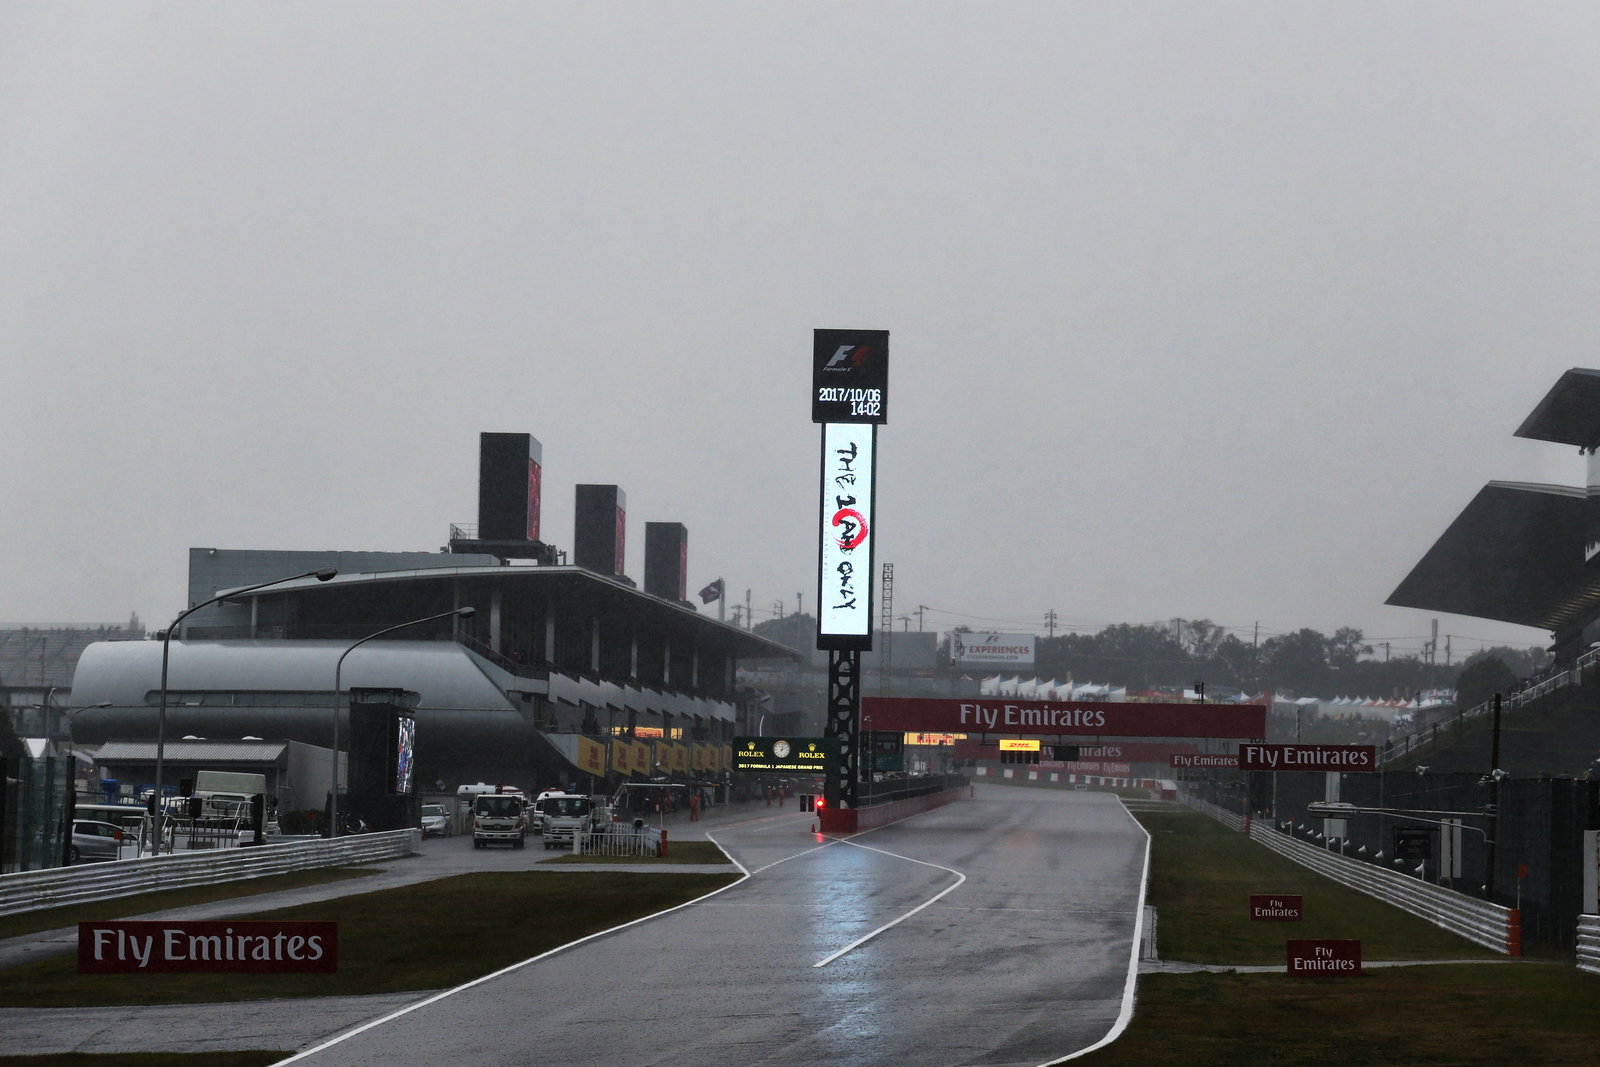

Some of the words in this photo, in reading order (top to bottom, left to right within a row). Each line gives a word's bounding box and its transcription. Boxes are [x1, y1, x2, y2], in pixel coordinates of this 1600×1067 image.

[819, 387, 881, 402] 2017/10/06
[850, 401, 881, 416] 14:02
[835, 442, 858, 490] THE
[832, 560, 857, 610] ONLY
[969, 645, 1029, 655] EXPERIENCES
[960, 703, 998, 729] Fly
[1004, 704, 1106, 727] Emirates
[738, 750, 765, 758] ROLEX
[798, 751, 825, 759] ROLEX
[1174, 756, 1192, 767] Fly
[1193, 756, 1239, 767] Emirates
[1247, 747, 1279, 767] Fly
[1284, 747, 1369, 765] Emirates
[1255, 907, 1298, 917] Emirates
[93, 929, 154, 968] Fly
[163, 927, 324, 961] Emirates
[1315, 947, 1333, 957] Fly
[1294, 957, 1355, 970] Emirates
